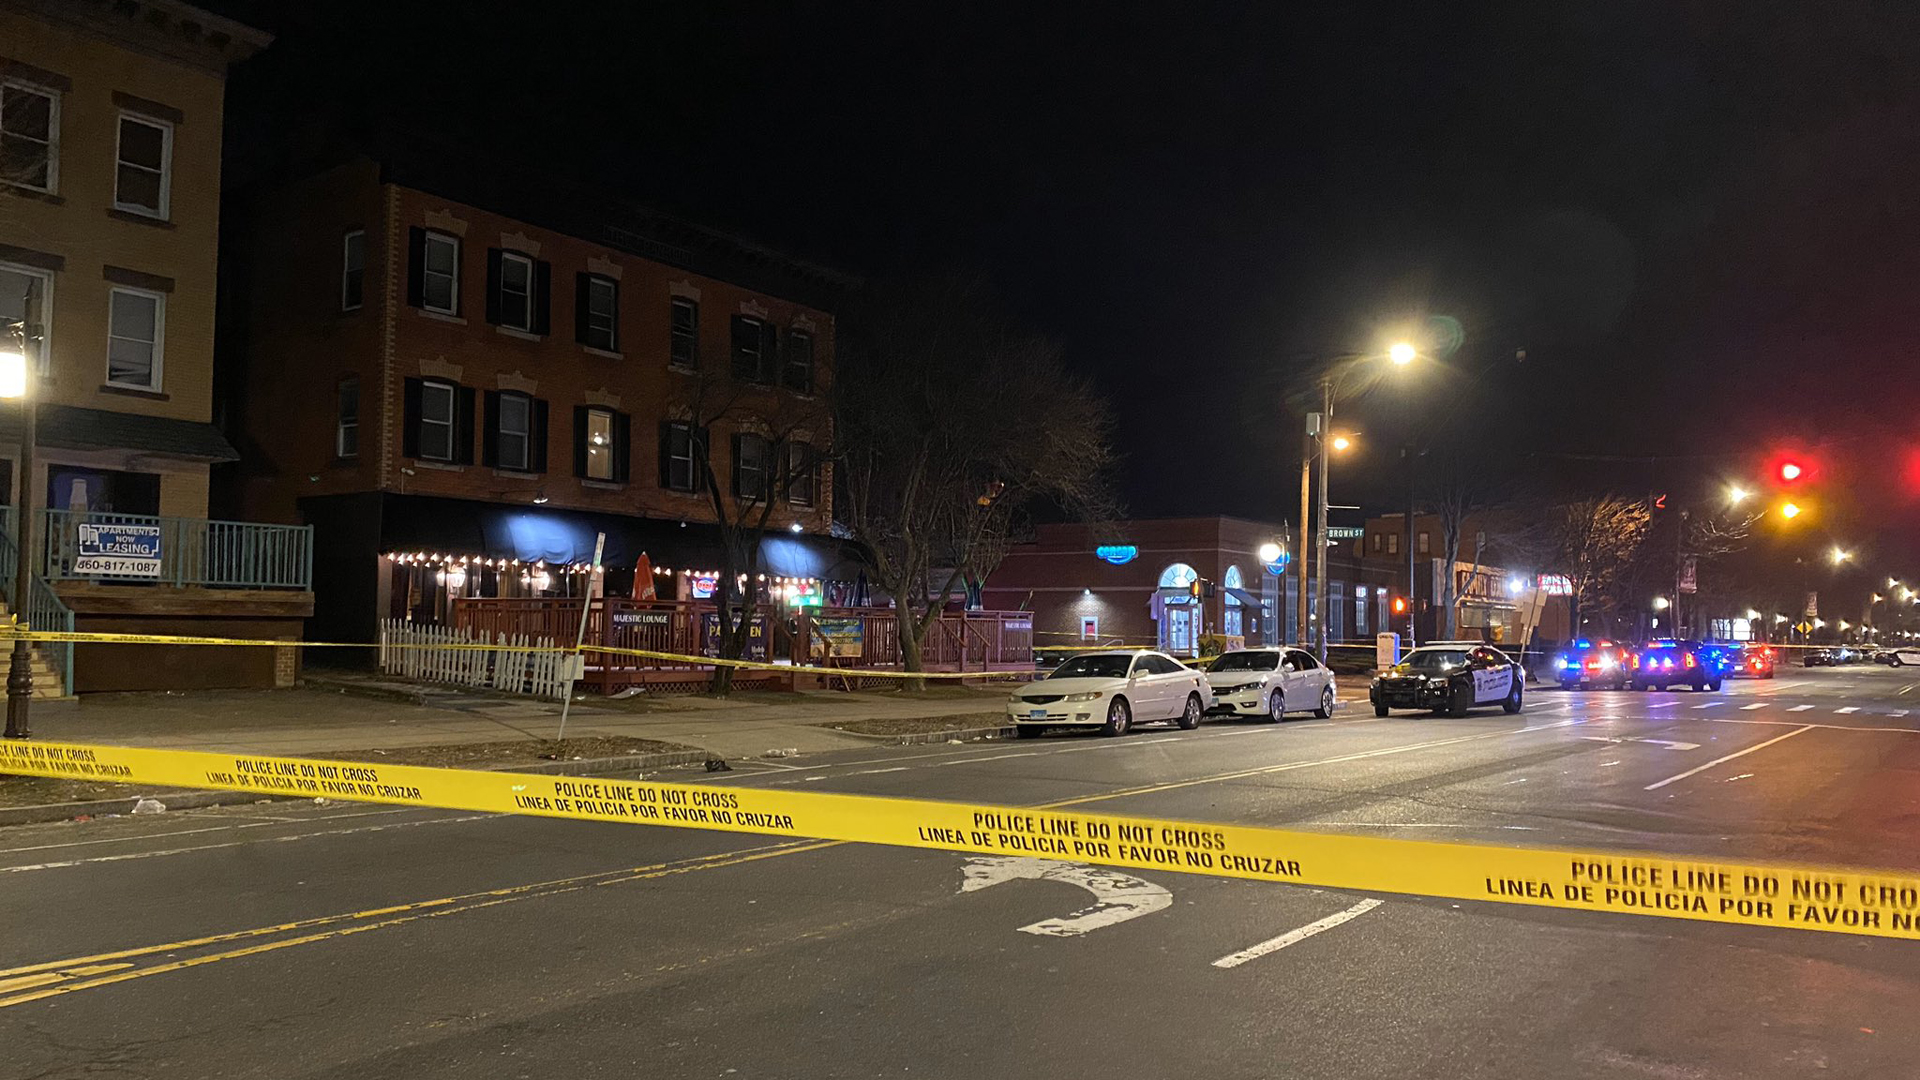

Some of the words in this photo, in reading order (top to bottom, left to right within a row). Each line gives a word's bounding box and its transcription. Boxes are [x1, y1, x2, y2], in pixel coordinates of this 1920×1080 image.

[98, 527, 155, 536] APARTMENTS
[1328, 529, 1354, 538] BROWN
[1354, 529, 1363, 537] ST
[100, 543, 150, 554] LEASING
[78, 560, 158, 572] 860-817-1087
[613, 614, 642, 624] MAJESTIC
[642, 614, 668, 624] LOUNGE
[13, 745, 31, 758] LINE
[32, 747, 45, 759] DO
[47, 748, 64, 760] NOT
[66, 749, 96, 763] CROSS
[0, 757, 28, 769] OLICIA
[30, 760, 47, 772] POR
[50, 761, 80, 774] FAVOR
[80, 764, 95, 775] NO
[95, 764, 133, 778] CRUZAR
[235, 760, 272, 774] POLICE
[274, 762, 299, 777] LINE
[300, 764, 315, 778] DO
[318, 766, 340, 780] NOT
[342, 768, 378, 782] CROSS
[205, 772, 236, 785] LINEA
[237, 774, 250, 786] DE
[254, 776, 295, 790] POLICIA
[297, 779, 318, 792] POR
[322, 781, 357, 796] FAVOR
[358, 784, 375, 796] NO
[378, 785, 422, 800] CRUZAR
[554, 782, 602, 799] POLICE
[604, 785, 635, 802] LINE
[638, 788, 656, 803] DO
[661, 790, 687, 806] NOT
[693, 791, 739, 809] CROSS
[514, 795, 552, 811] LINEA
[556, 799, 572, 812] DE
[576, 800, 628, 816] POLICIA
[632, 805, 659, 820] POR
[663, 807, 709, 825] FAVOR
[712, 810, 732, 826] NO
[736, 812, 794, 830] CRUZAR
[972, 812, 1036, 834] POLICE
[1040, 817, 1080, 838] LINE
[1087, 819, 1110, 841] DO
[1118, 822, 1154, 846] NOT
[1162, 828, 1226, 852] CROSS
[918, 826, 966, 846] LINEA
[971, 831, 993, 848] DE
[998, 834, 1068, 856] POLICIA
[1074, 840, 1111, 859] POR
[1118, 844, 1181, 866] FAVOR
[1186, 851, 1213, 869] NO
[1220, 854, 1302, 877] CRUZAR
[1570, 859, 1663, 889] POLICE
[1672, 864, 1731, 895] LINE
[1743, 872, 1780, 899] DO
[1792, 876, 1848, 906] NOT
[1858, 880, 1920, 911] CRO
[1484, 876, 1554, 900] LINEA
[1564, 885, 1594, 904] DE
[1605, 887, 1708, 914] POLICIA
[1719, 898, 1774, 920] POR
[1788, 903, 1881, 929] FAVOR
[1892, 910, 1920, 933] NO
